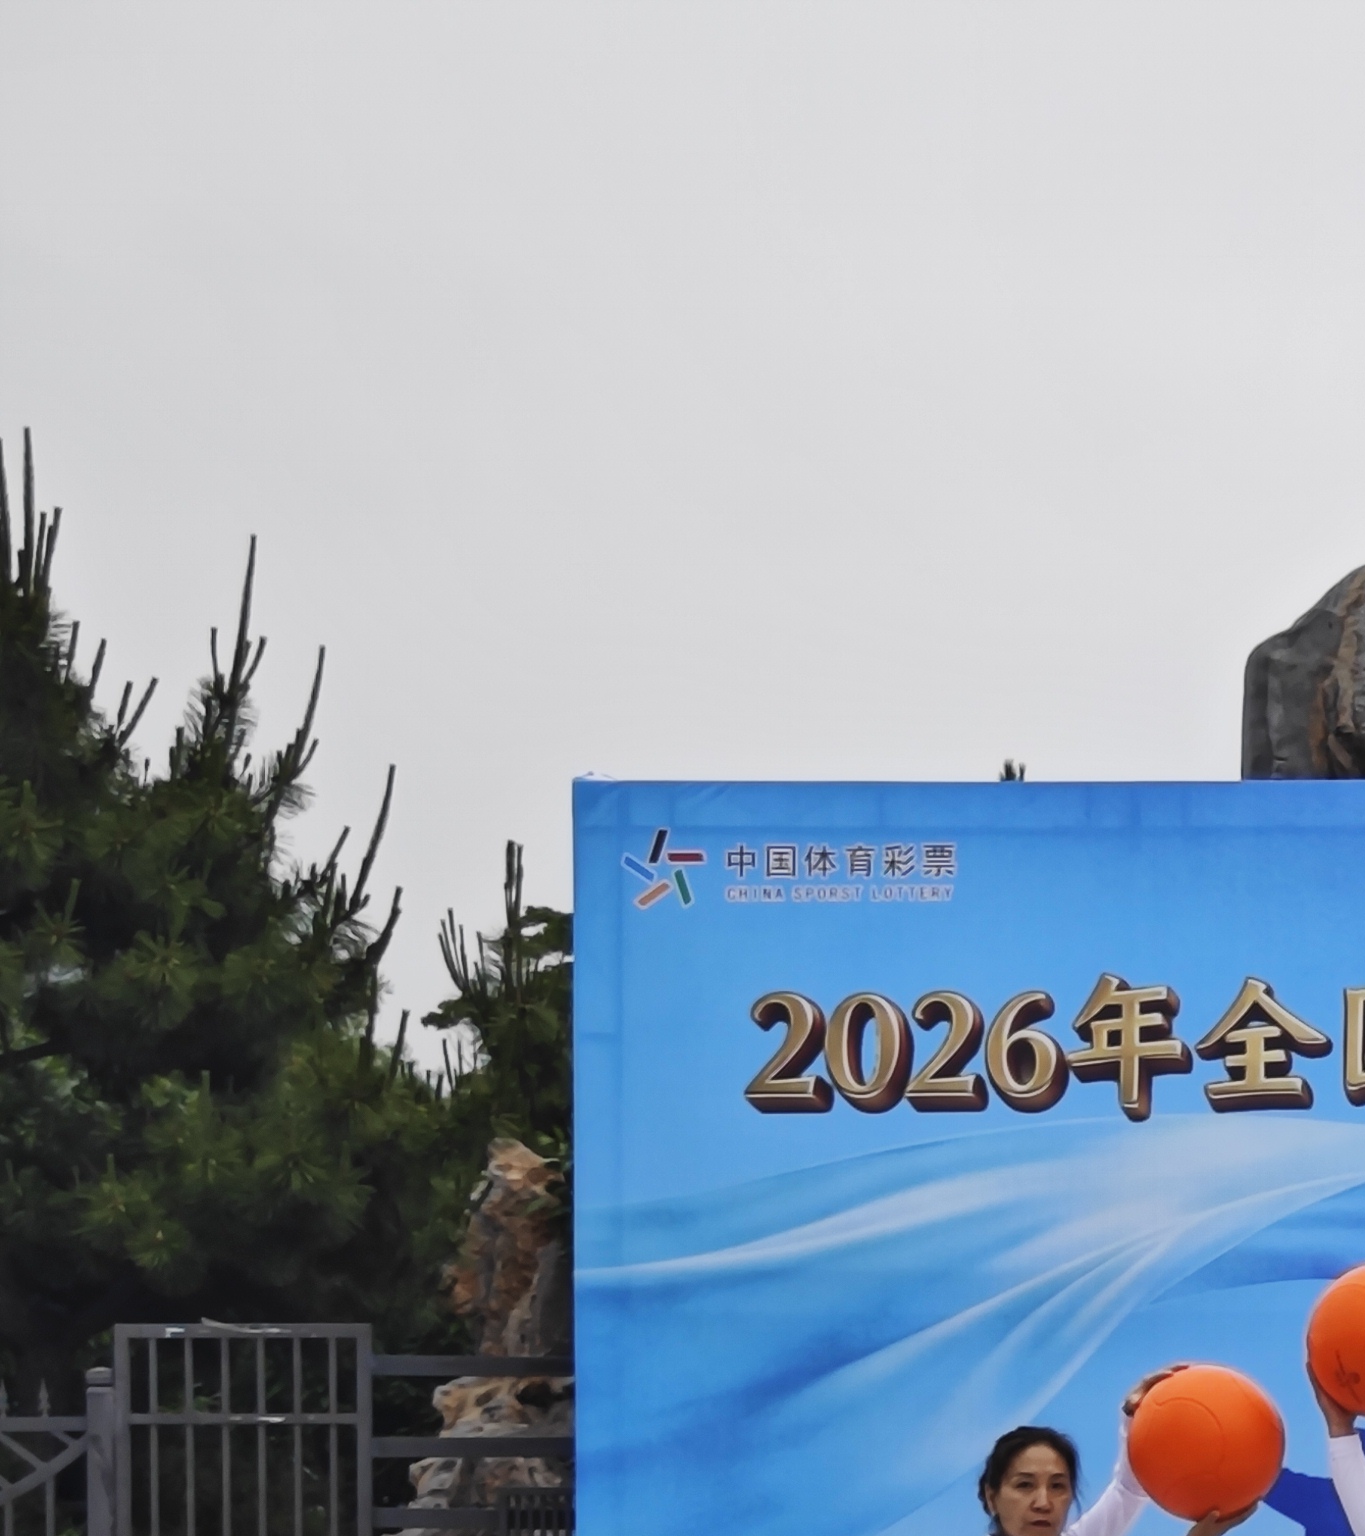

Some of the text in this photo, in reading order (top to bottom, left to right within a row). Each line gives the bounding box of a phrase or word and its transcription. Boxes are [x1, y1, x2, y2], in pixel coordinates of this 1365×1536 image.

[726, 844, 957, 879] 中国体育彩票
[727, 887, 784, 901] CHINA
[871, 885, 953, 901] LOTTERY
